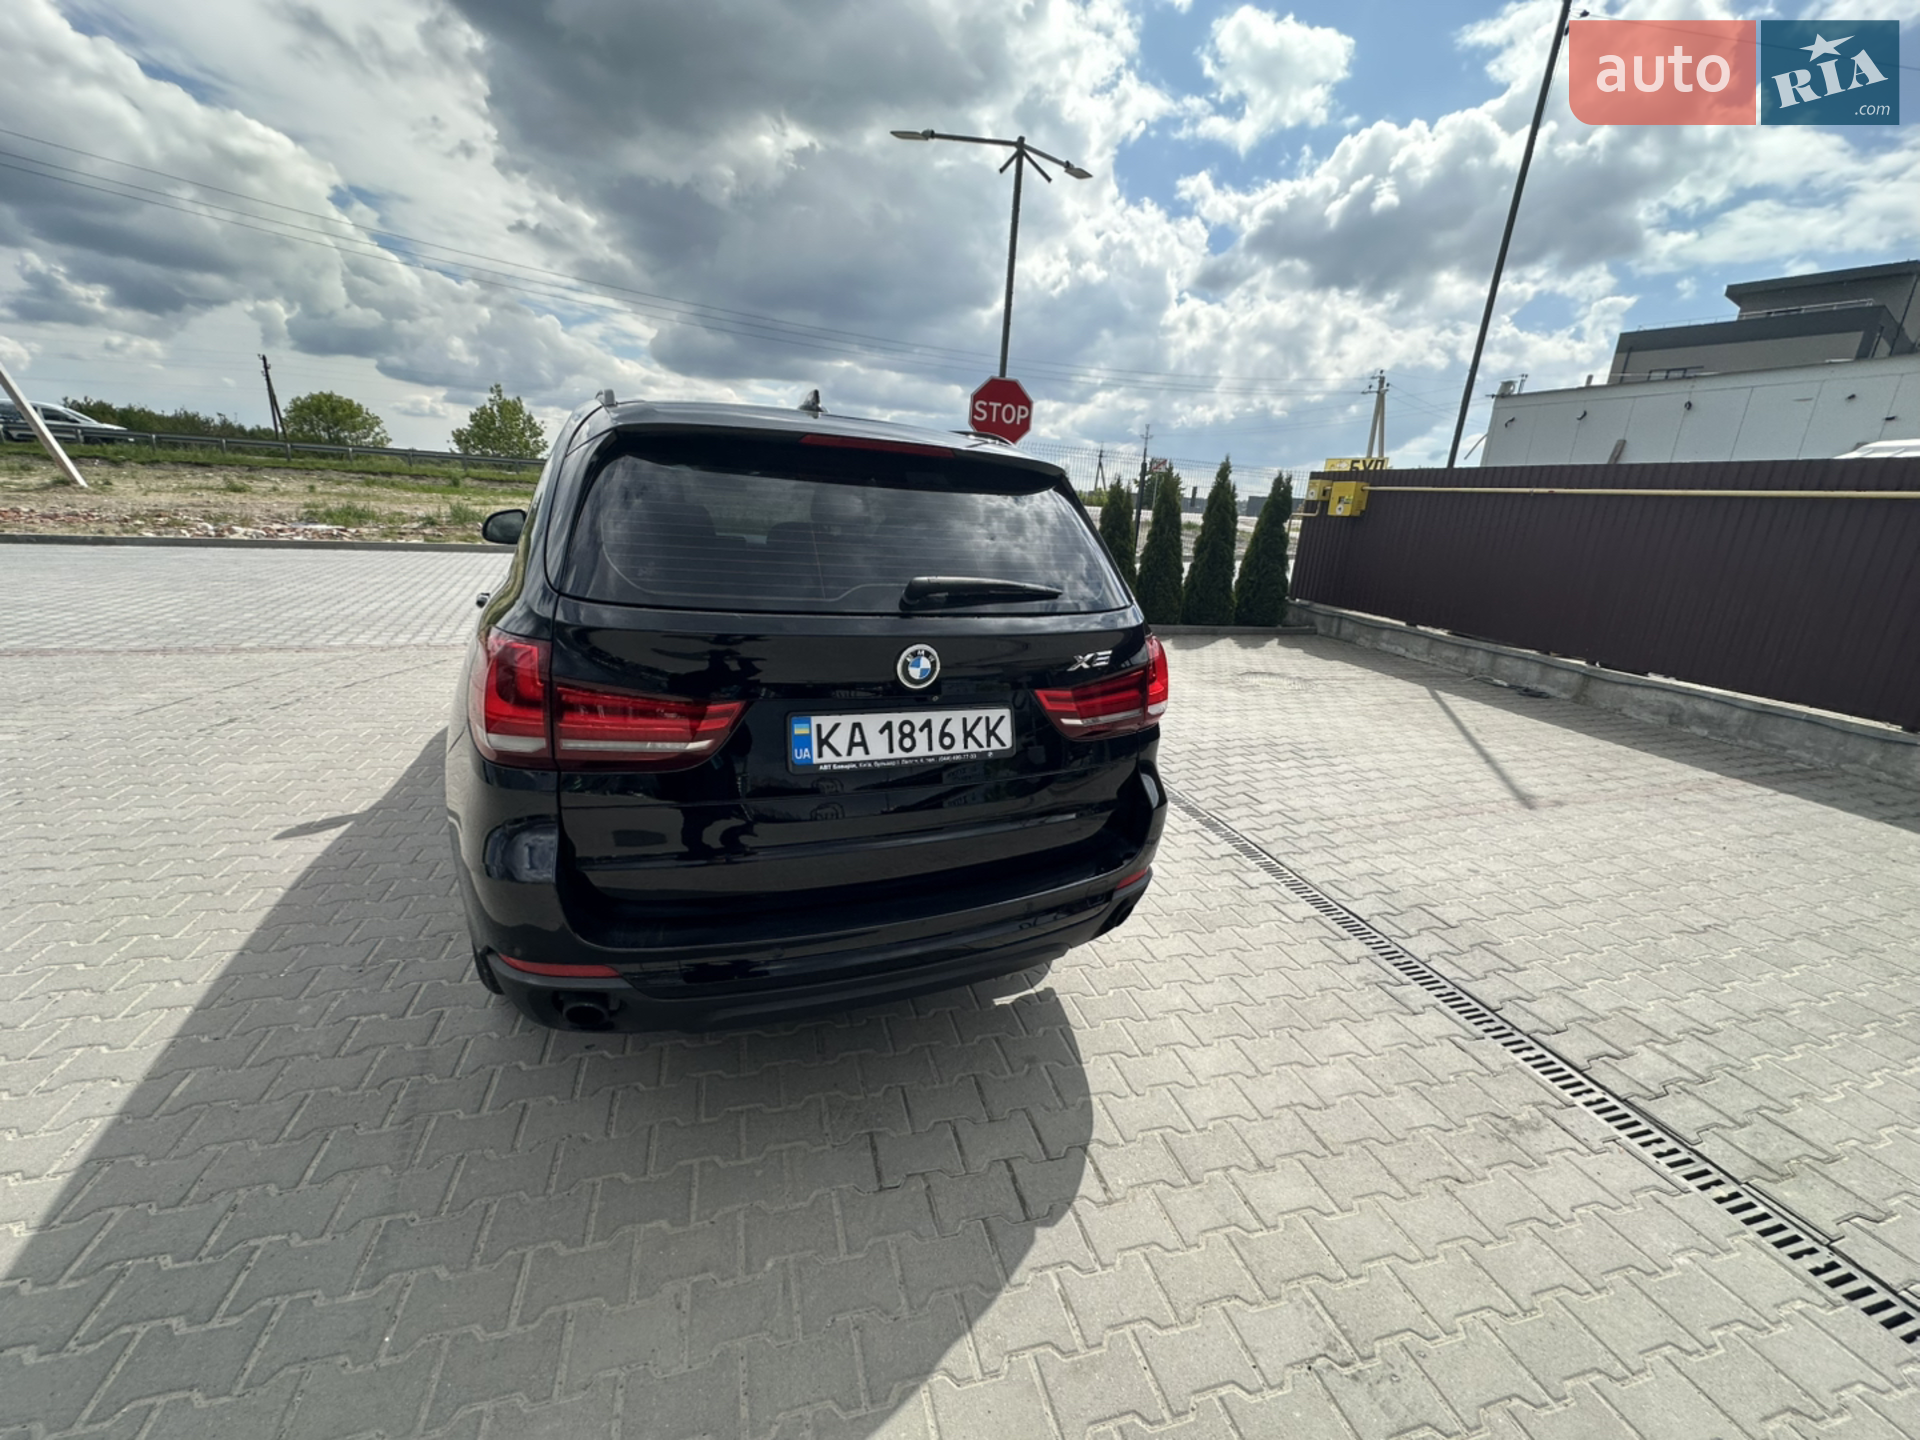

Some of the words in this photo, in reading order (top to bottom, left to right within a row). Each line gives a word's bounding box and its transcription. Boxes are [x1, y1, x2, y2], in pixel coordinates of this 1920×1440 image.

[973, 400, 1030, 425] STOP
[1066, 649, 1113, 672] X5
[878, 718, 956, 754] 1816
[794, 748, 812, 760] UA
